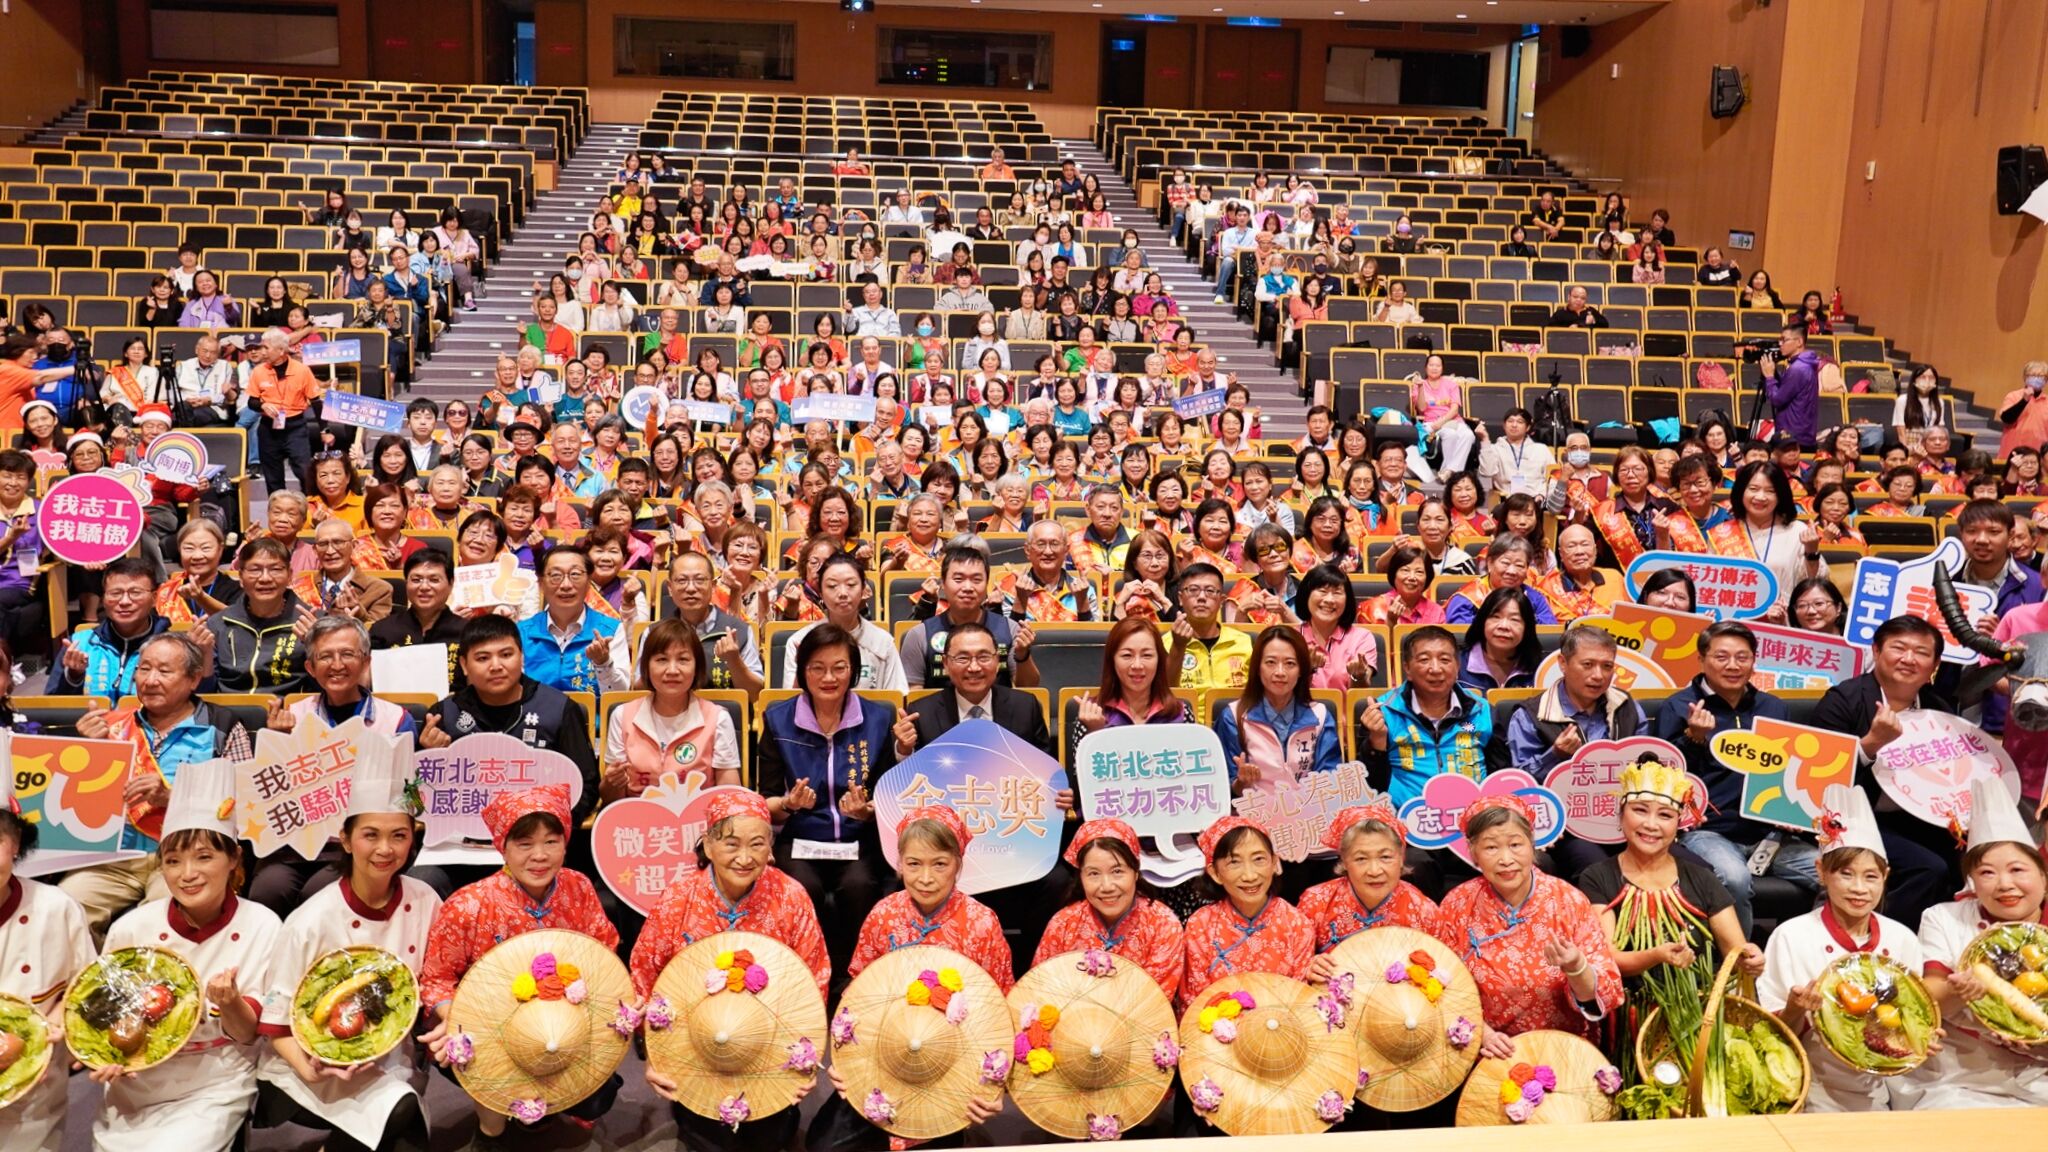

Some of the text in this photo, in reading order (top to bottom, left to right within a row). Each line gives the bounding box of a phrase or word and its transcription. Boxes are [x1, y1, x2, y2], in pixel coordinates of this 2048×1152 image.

[157, 453, 191, 474] 陶博
[52, 494, 132, 520] 我志工
[49, 519, 129, 546] 我驕傲
[1682, 564, 1758, 588] 志力傳承
[1856, 572, 1892, 625] 志工
[1754, 636, 1841, 673] 陣來去
[524, 711, 540, 726] 林
[1091, 748, 1213, 779] 新北志工
[1719, 738, 1783, 767] let's go
[1881, 733, 1987, 771] 志在新北
[15, 771, 46, 791] go
[252, 739, 356, 800] 我志工
[418, 757, 535, 785] 新北志工
[1094, 784, 1218, 817] 志力不凡
[1235, 765, 1375, 825] 志心奉獻
[1566, 791, 1620, 819] 溫暖
